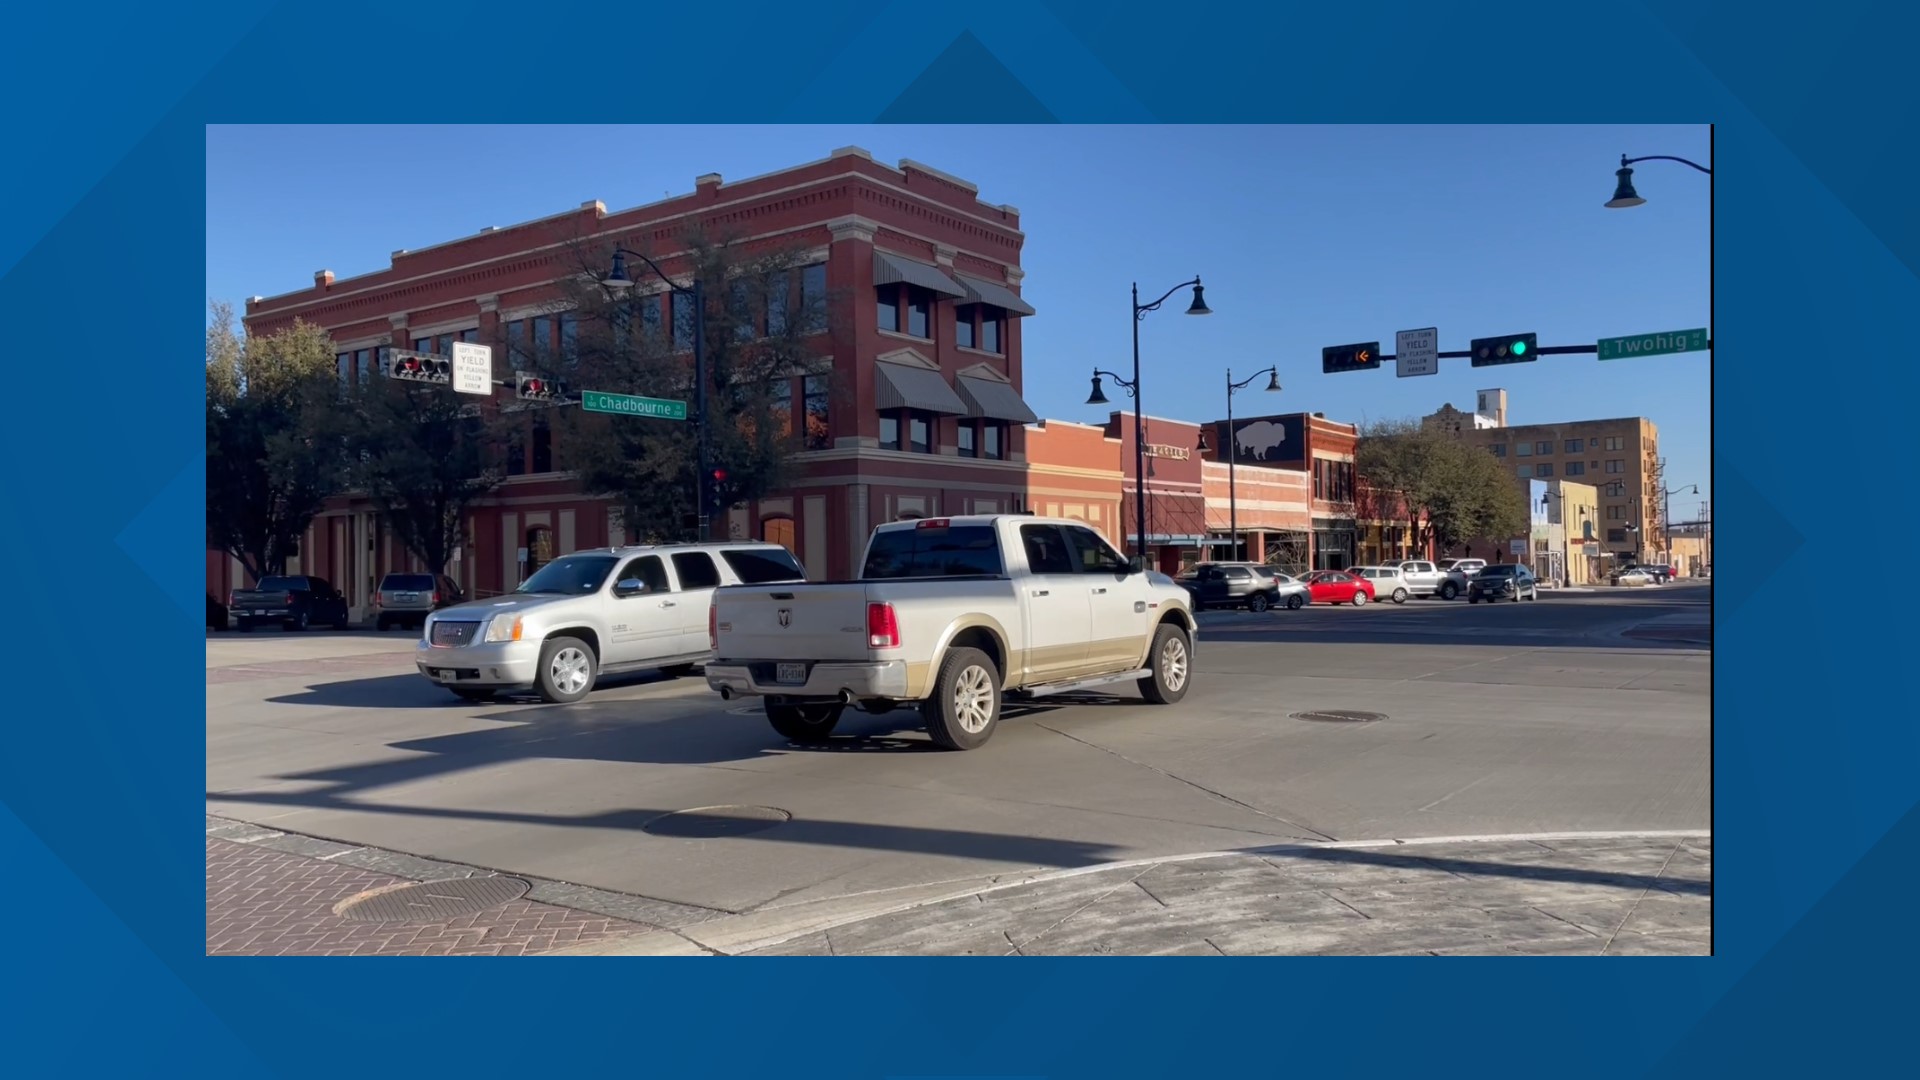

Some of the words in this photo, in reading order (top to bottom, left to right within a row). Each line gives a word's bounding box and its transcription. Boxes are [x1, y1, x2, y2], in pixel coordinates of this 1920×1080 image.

[1406, 340, 1428, 349] YIELD
[1615, 333, 1687, 352] Twohig
[461, 355, 485, 366] YIELD
[599, 396, 671, 415] Chadbourne
